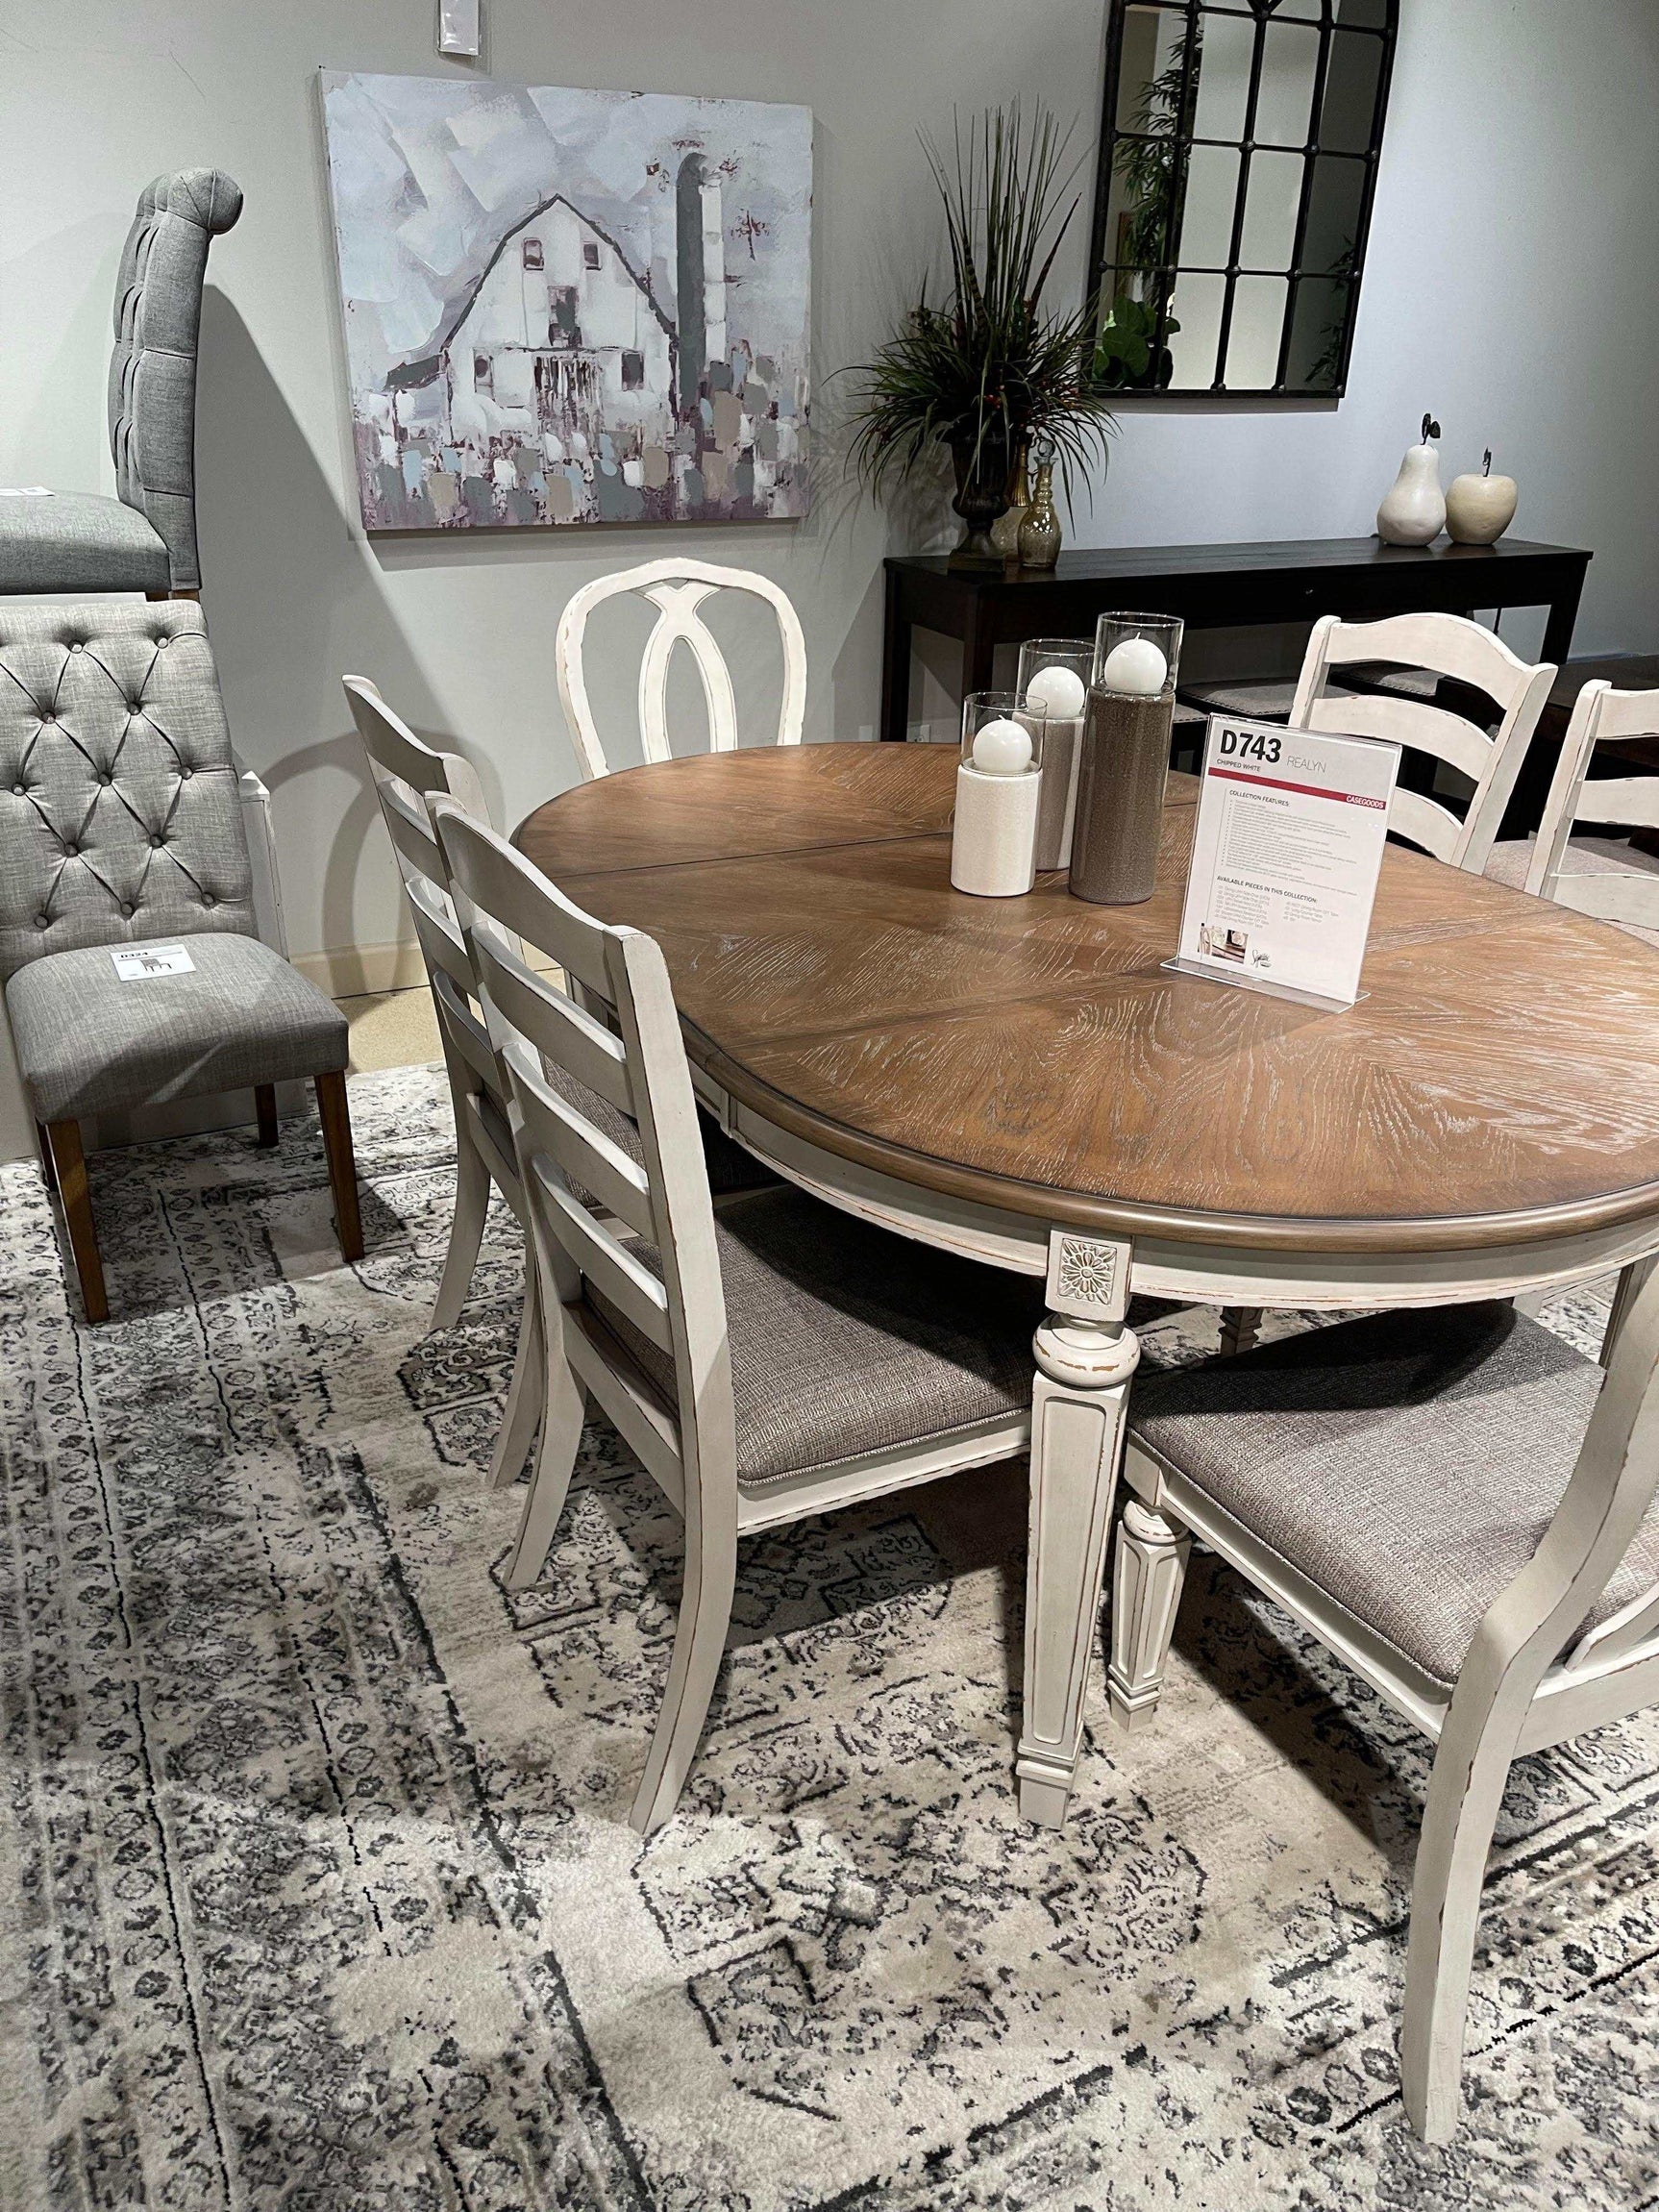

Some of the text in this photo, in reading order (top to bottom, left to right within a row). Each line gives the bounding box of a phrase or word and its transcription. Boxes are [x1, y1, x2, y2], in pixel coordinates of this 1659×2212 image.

[1220, 729, 1326, 774] D743 REALYN
[1217, 758, 1261, 773] CHIPPED WHITE
[1229, 789, 1261, 802] COLLECTION
[1346, 794, 1384, 809] CASEGOODS
[1217, 875, 1244, 887] AVAILABLE
[1245, 882, 1264, 891] PIECES
[1271, 887, 1283, 896] THIS
